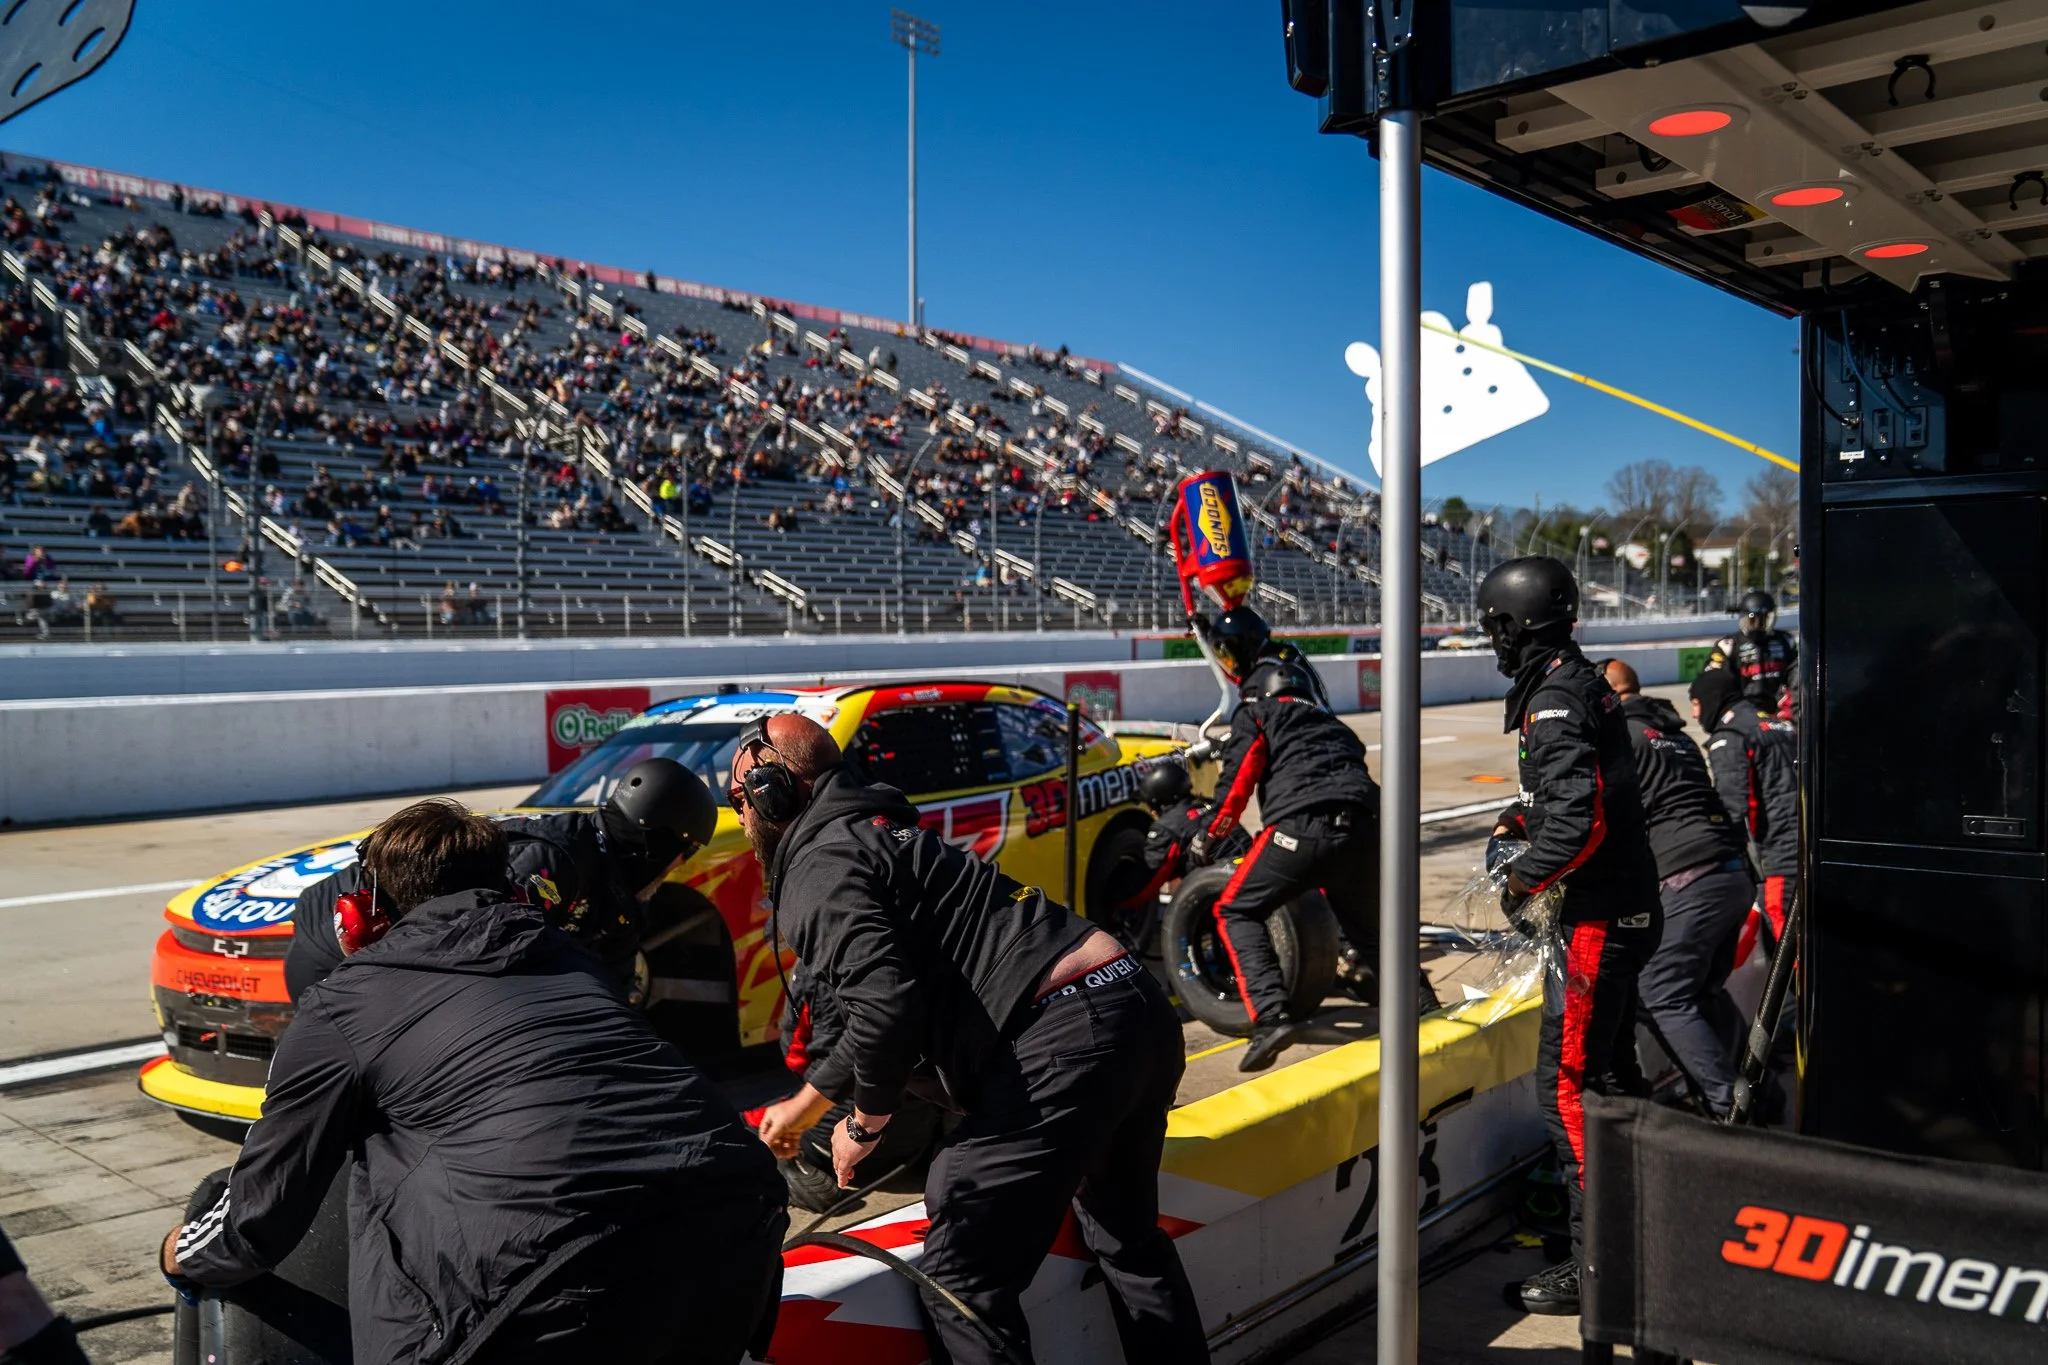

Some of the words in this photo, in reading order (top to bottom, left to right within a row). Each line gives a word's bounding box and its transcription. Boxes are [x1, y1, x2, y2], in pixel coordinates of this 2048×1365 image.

[1202, 487, 1229, 553] SUNOCO
[1536, 709, 1570, 720] NASCAR
[176, 968, 261, 993] CHEVROLET
[1720, 1205, 2048, 1324] 3Dimen
